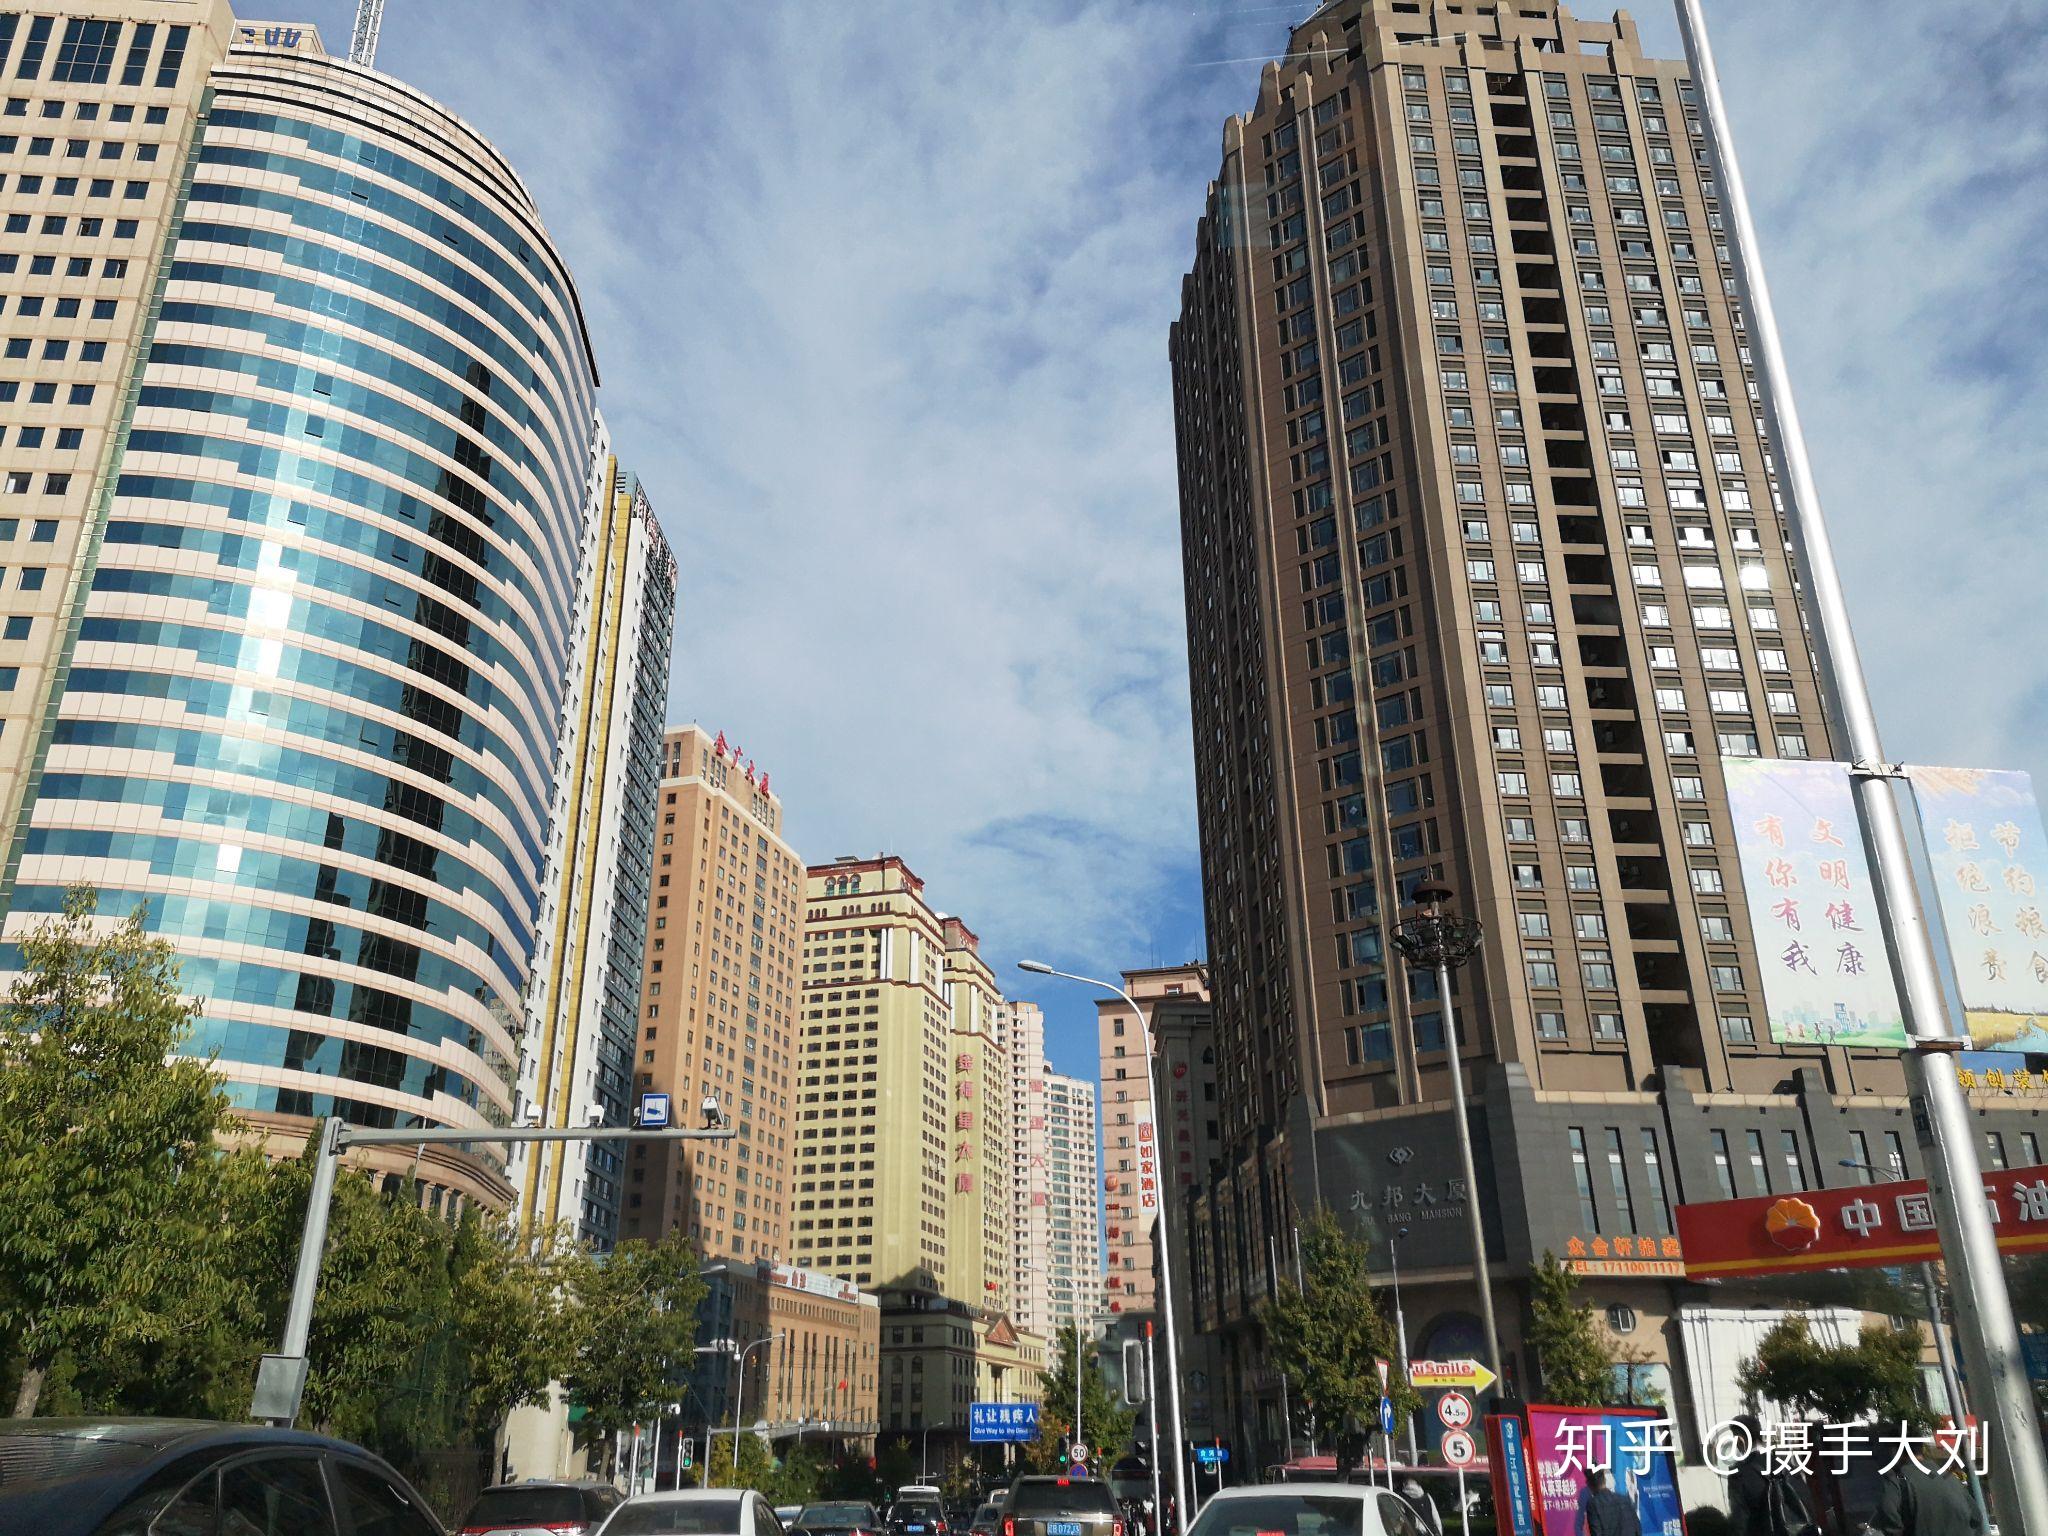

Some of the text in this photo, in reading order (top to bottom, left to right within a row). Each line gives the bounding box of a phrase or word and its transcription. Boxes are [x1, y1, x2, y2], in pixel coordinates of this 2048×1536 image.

[1754, 816, 1818, 976] 有你有我
[1809, 818, 1866, 976] 文明健康
[1943, 819, 2007, 981] 拒绝浪费
[1140, 1145, 1156, 1207] 如家酒店
[1350, 1178, 1468, 1211] 九邦大厦
[1388, 1212, 1412, 1224] BANG
[1421, 1208, 1463, 1220] MANSION
[974, 1408, 1036, 1424] 礼让残疾人
[986, 1427, 998, 1435] Way
[1073, 1448, 1085, 1458] 50
[1453, 1441, 1465, 1457] 5
